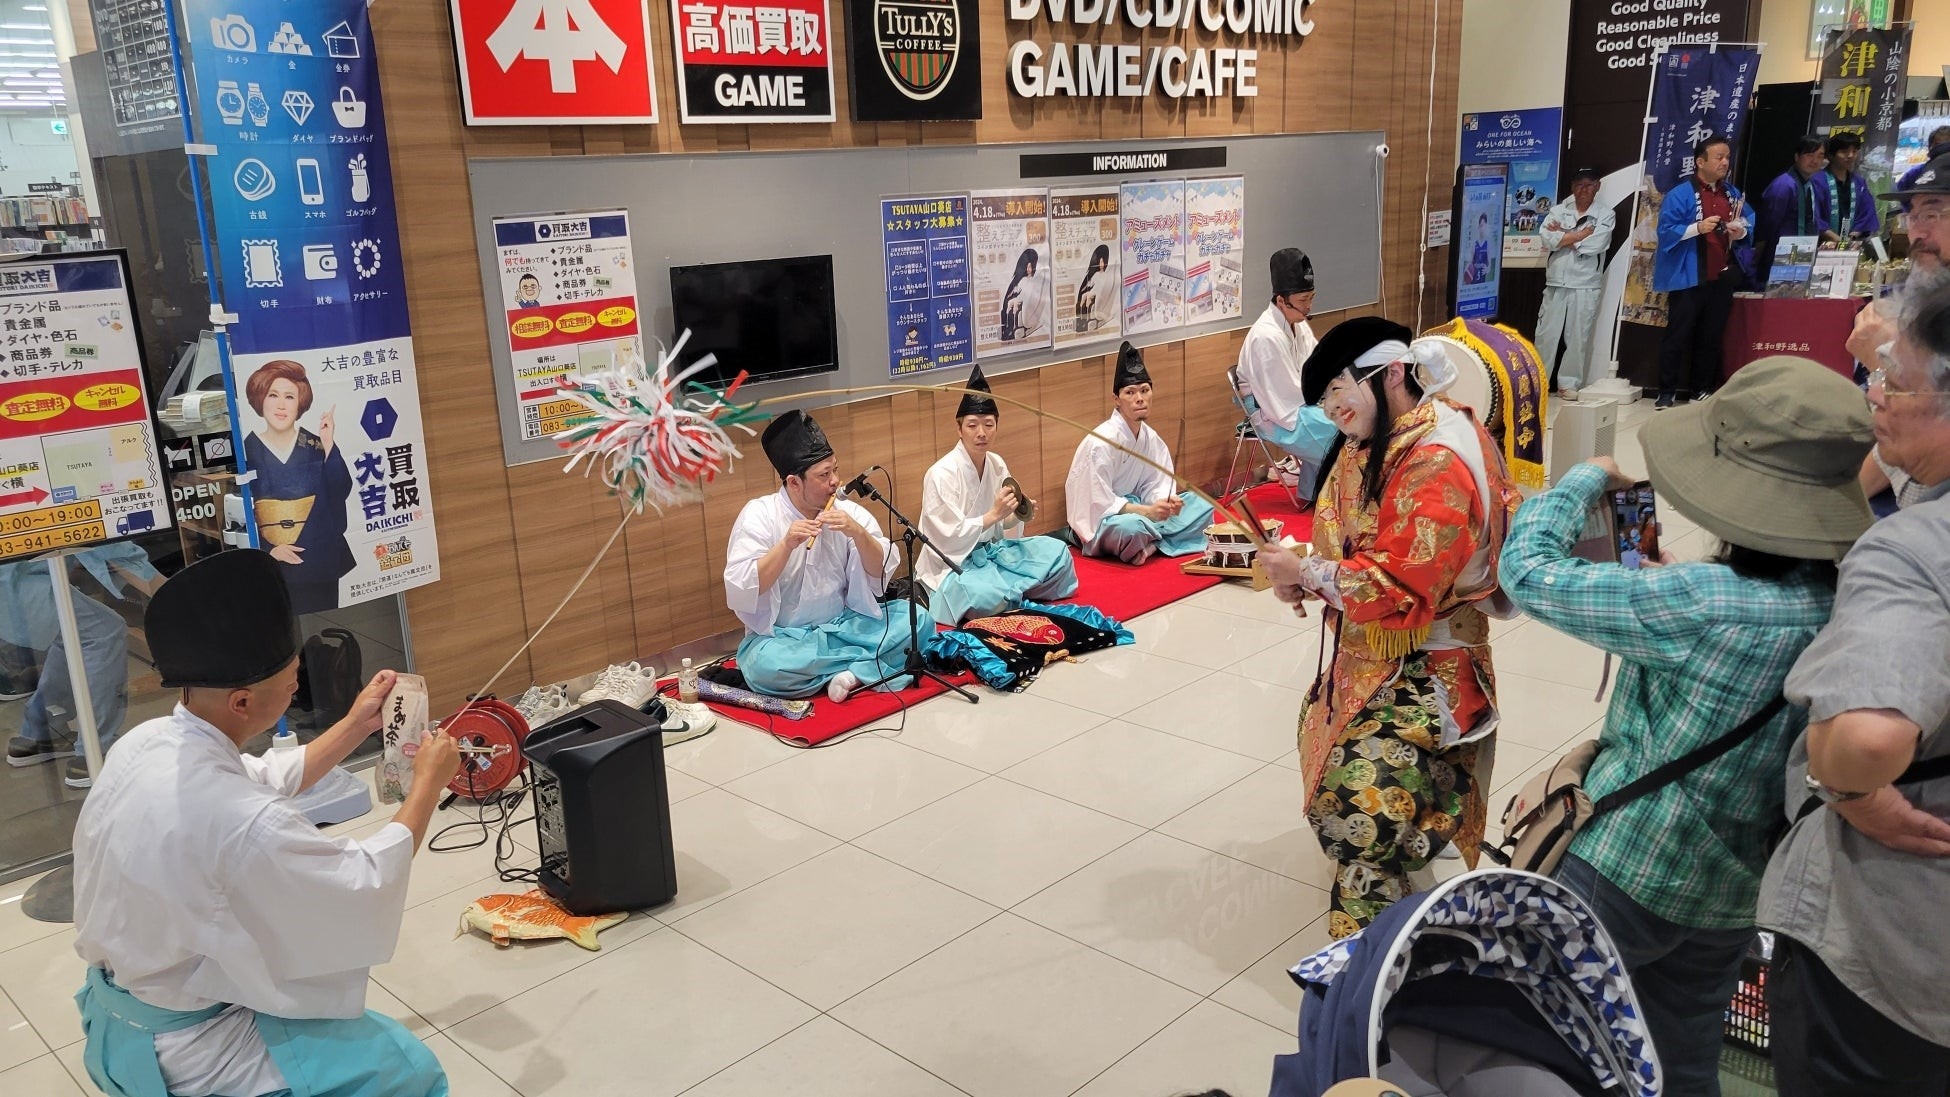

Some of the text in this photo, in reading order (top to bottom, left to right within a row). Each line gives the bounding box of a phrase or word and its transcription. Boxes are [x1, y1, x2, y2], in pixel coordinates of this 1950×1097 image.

[1610, 1, 1649, 16] Good
[682, 3, 822, 56] 高価買取
[881, 7, 953, 37] TULLY'S
[1596, 11, 1721, 36] Reasonable Price
[896, 39, 941, 51] COFFEE
[1595, 38, 1634, 53] Good
[224, 54, 249, 65] カメラ
[288, 60, 297, 70] 金
[1607, 55, 1646, 70] Good
[335, 63, 351, 73] 金券
[1011, 39, 1258, 99] GAME/CAFE
[714, 73, 806, 108] GAME
[1875, 41, 1903, 132] 山陰の小京都
[239, 131, 259, 141] 時計
[292, 134, 313, 143] ダイヤ
[329, 133, 374, 143] ブランドバッグ
[1476, 138, 1542, 149] みらいの美しい海へ
[1093, 153, 1168, 172] INFORMATION
[346, 206, 377, 217] ゴルフバッグ
[892, 200, 952, 216] TSUTAYA山口葵店
[1006, 200, 1046, 216] 導入開始!
[1081, 198, 1118, 214] 導入開始!
[249, 210, 267, 220] 古銭
[304, 211, 327, 219] スマホ
[1188, 209, 1240, 229] アミューズメント
[552, 221, 588, 234] 買取大吉
[1125, 214, 1182, 235] アミューズメント
[976, 222, 1022, 243] 整えチェア
[557, 244, 593, 255] ブランド品
[1137, 248, 1172, 264] ガチャガチャ
[1199, 242, 1231, 257] ガチャガチャ
[504, 256, 550, 267] 何でも持ってきて
[560, 256, 584, 267] 貴金属
[0, 268, 51, 287] 取大吉
[561, 266, 601, 278] ダイヤ・色石
[19, 283, 49, 291] DAIKICHI
[562, 278, 586, 289] 商品券
[316, 296, 332, 305] 財布
[353, 290, 388, 301] アクセサリー
[564, 288, 604, 300] 切手・テレカ
[0, 300, 62, 315] ブランド品
[260, 299, 279, 308] 切手
[604, 309, 627, 317] キャンセル
[4, 316, 47, 331] 貴金属
[515, 320, 550, 334] 相談無料
[559, 315, 592, 329] 査定無料
[7, 329, 78, 346] ダイヤ・色石
[10, 347, 53, 362] 商品券
[69, 347, 94, 356] 商品券
[321, 347, 399, 372] 大吉の豊富な
[537, 355, 556, 364] 場所は
[13, 359, 83, 377] 切手・テレカ
[517, 362, 577, 378] TSUTAYA山口葵店
[353, 369, 402, 391] 買取品目
[85, 386, 126, 398] キャンセル
[5, 396, 66, 417] 査定無料
[98, 398, 118, 408] 無料
[121, 437, 137, 445] アルク
[66, 461, 93, 471] TSUTAYA
[385, 443, 420, 511] 買取
[172, 482, 221, 502] OPEN
[353, 452, 387, 520] 大吉
[112, 491, 154, 505] 出張買取も
[105, 498, 163, 515] おこなってます!!
[366, 512, 414, 533] DAIKICHI
